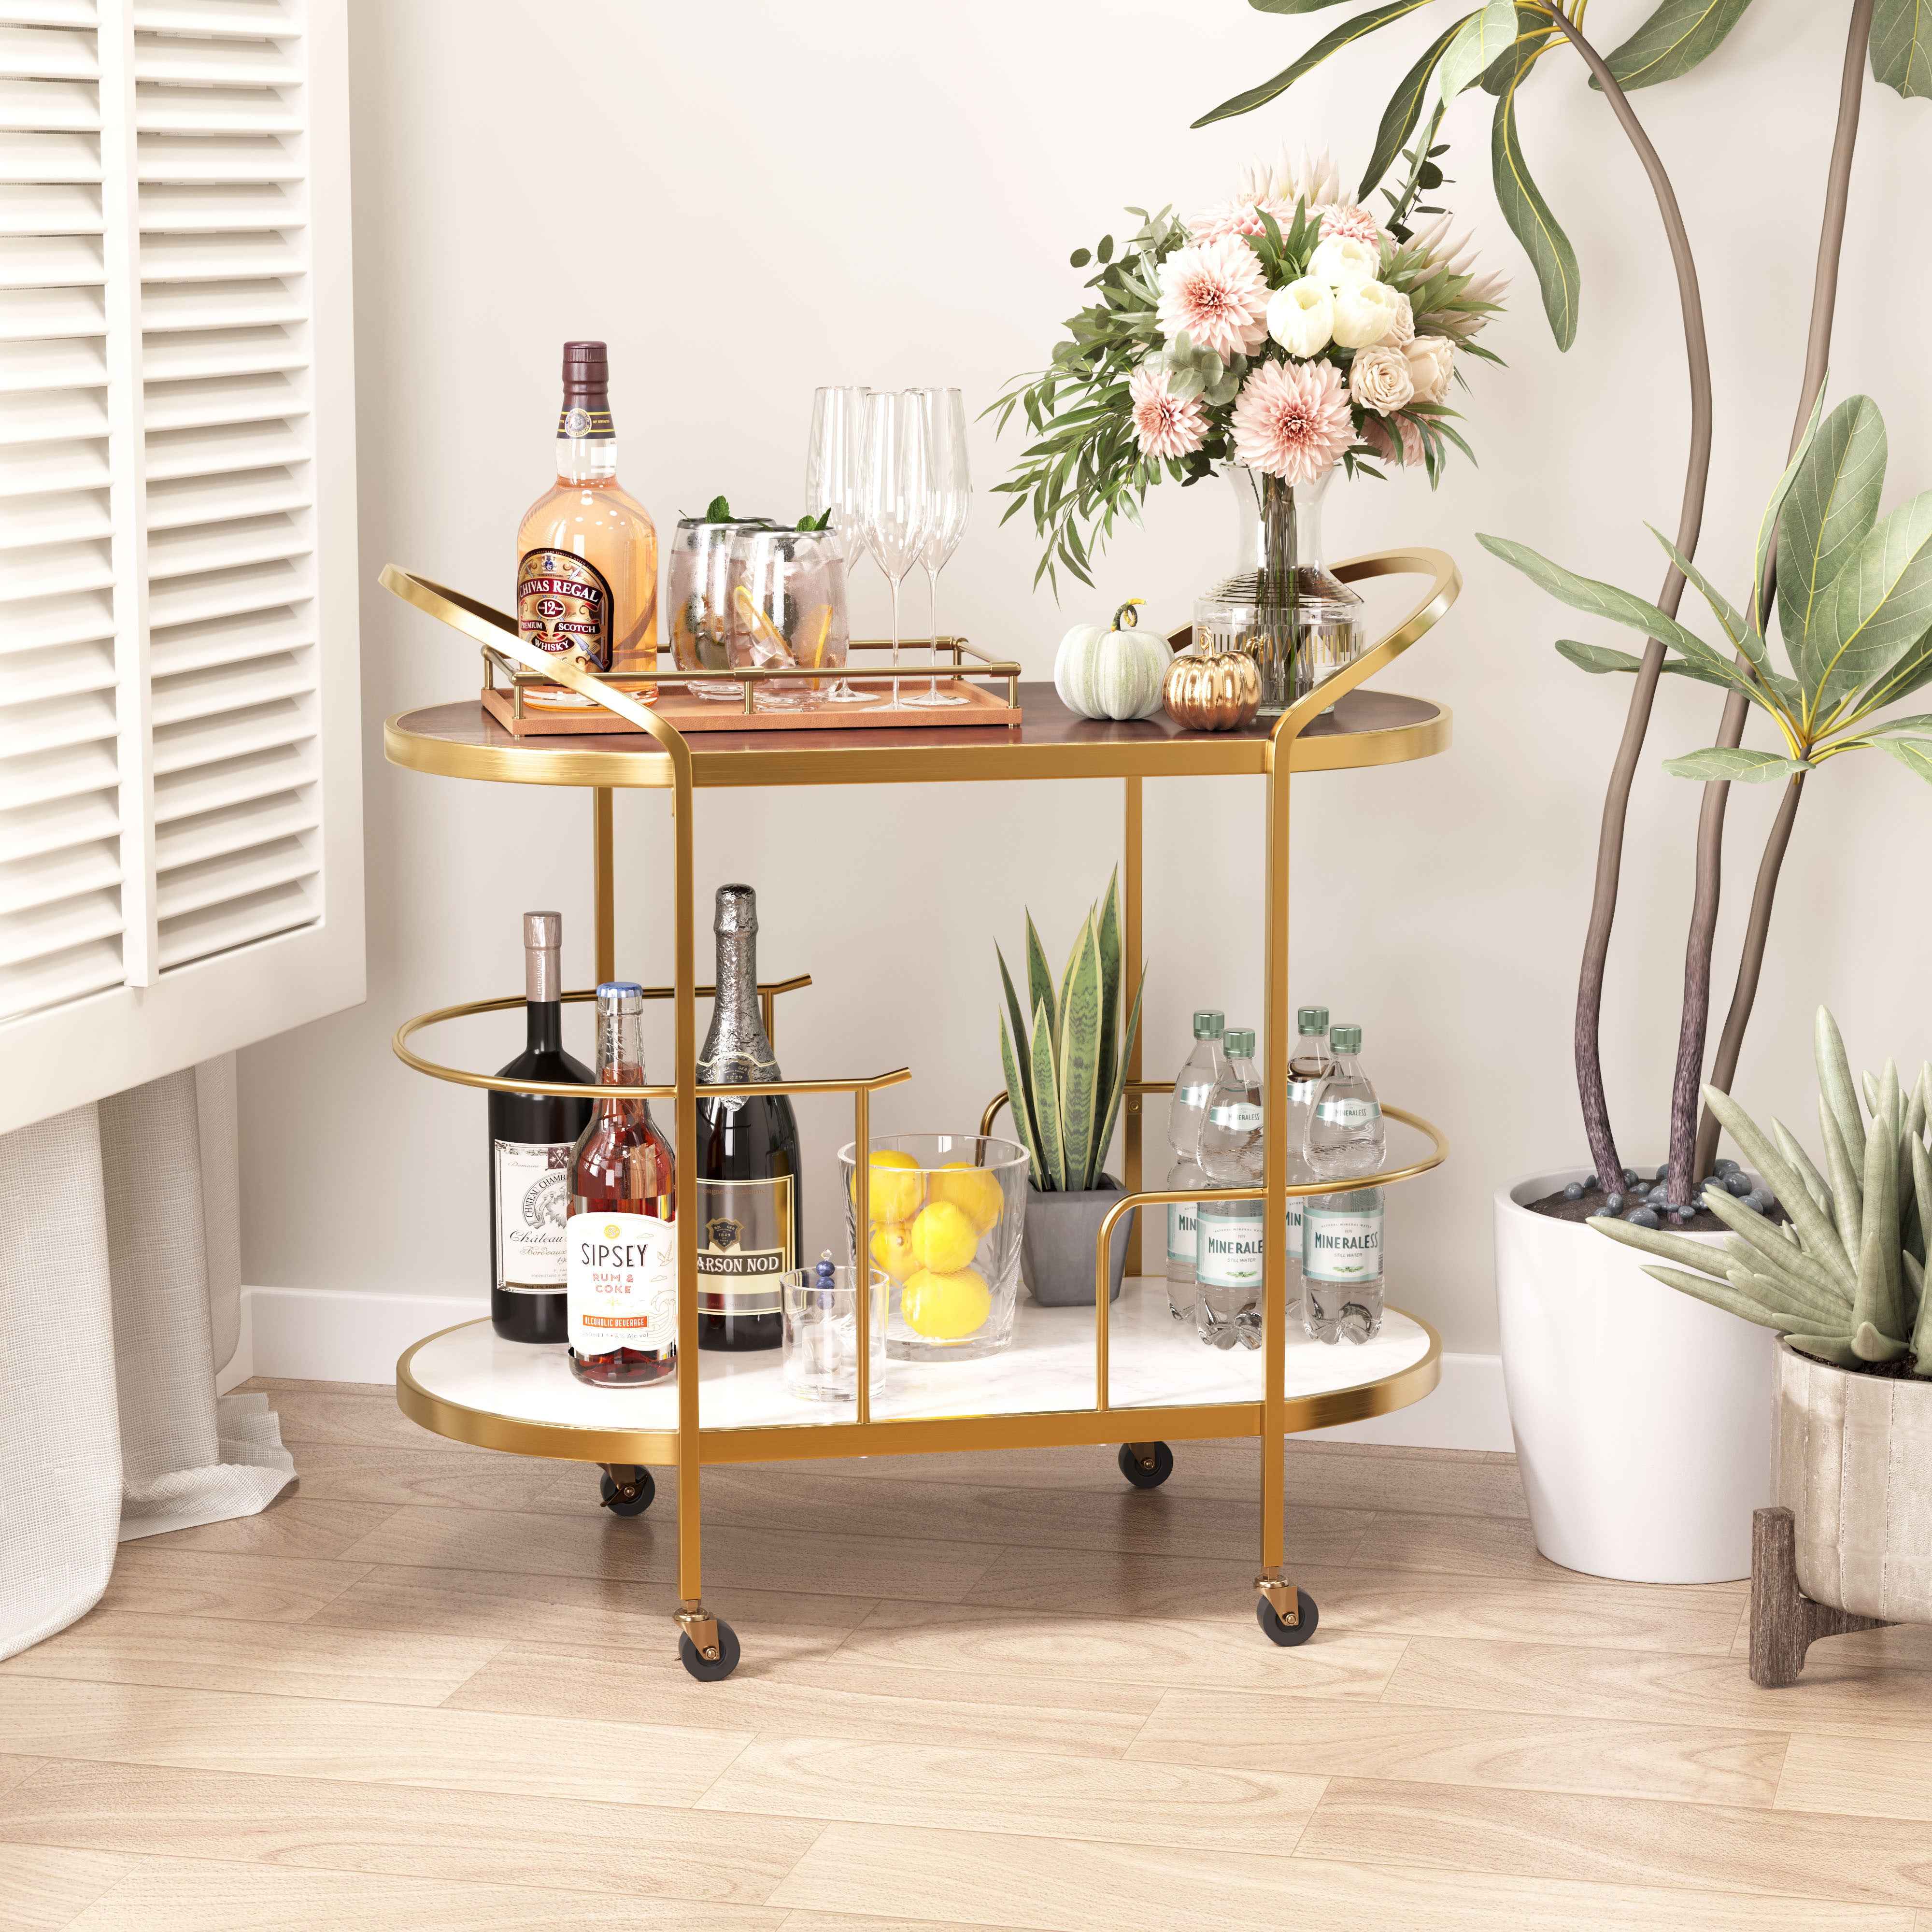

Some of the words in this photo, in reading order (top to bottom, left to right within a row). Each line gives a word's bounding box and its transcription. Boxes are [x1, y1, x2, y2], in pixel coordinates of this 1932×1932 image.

[520, 580, 550, 597] CHIVAS
[553, 580, 599, 602] REGAL
[543, 601, 555, 615] 12
[558, 623, 596, 633] SCOTCH
[534, 639, 569, 651] WHISKY
[525, 1186, 540, 1218] CHATEAU
[539, 1174, 567, 1189] CHAMB
[1208, 1237, 1263, 1254] MINERALE
[1315, 1232, 1378, 1249] MINERALESS
[582, 1243, 649, 1267] SIPSEY
[697, 1257, 743, 1273] ARSON
[747, 1257, 779, 1272] NOD
[593, 1273, 621, 1282] RUM
[626, 1274, 634, 1283] &
[596, 1285, 631, 1294] COKE
[585, 1317, 613, 1327] ALCOHOLIC
[615, 1317, 644, 1327] BEVERAGE
